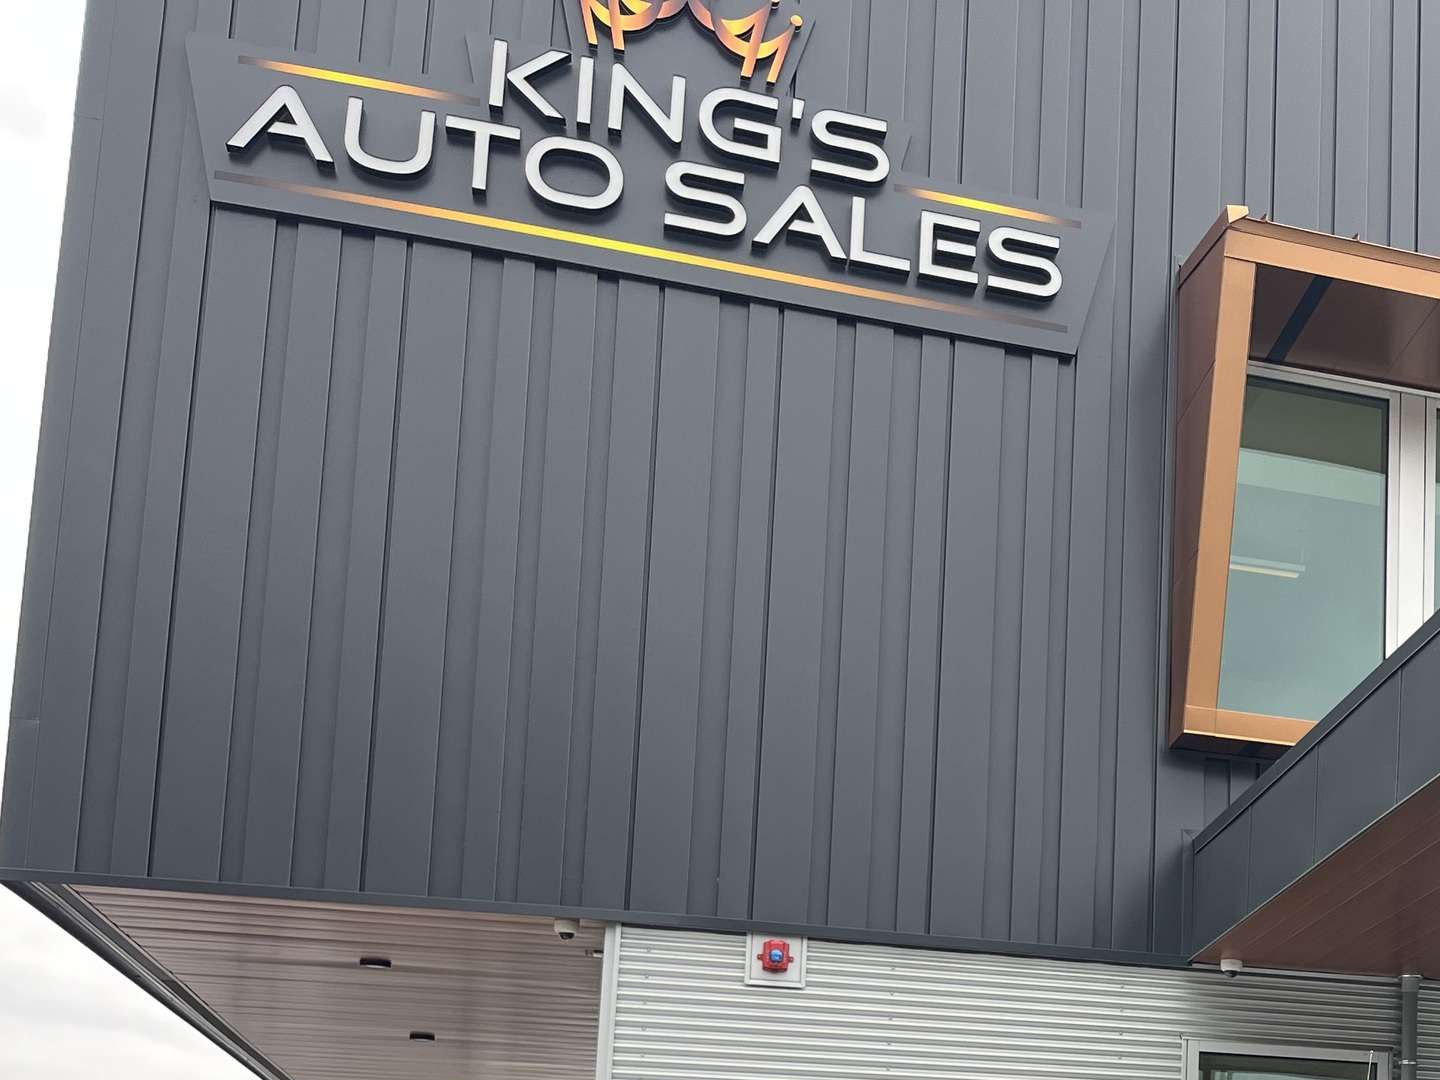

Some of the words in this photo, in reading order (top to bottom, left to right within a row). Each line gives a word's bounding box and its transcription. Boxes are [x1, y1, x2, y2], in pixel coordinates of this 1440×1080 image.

[225, 84, 625, 212] AUTO
[663, 160, 1065, 301] SALES
[488, 37, 891, 184] KING'S
